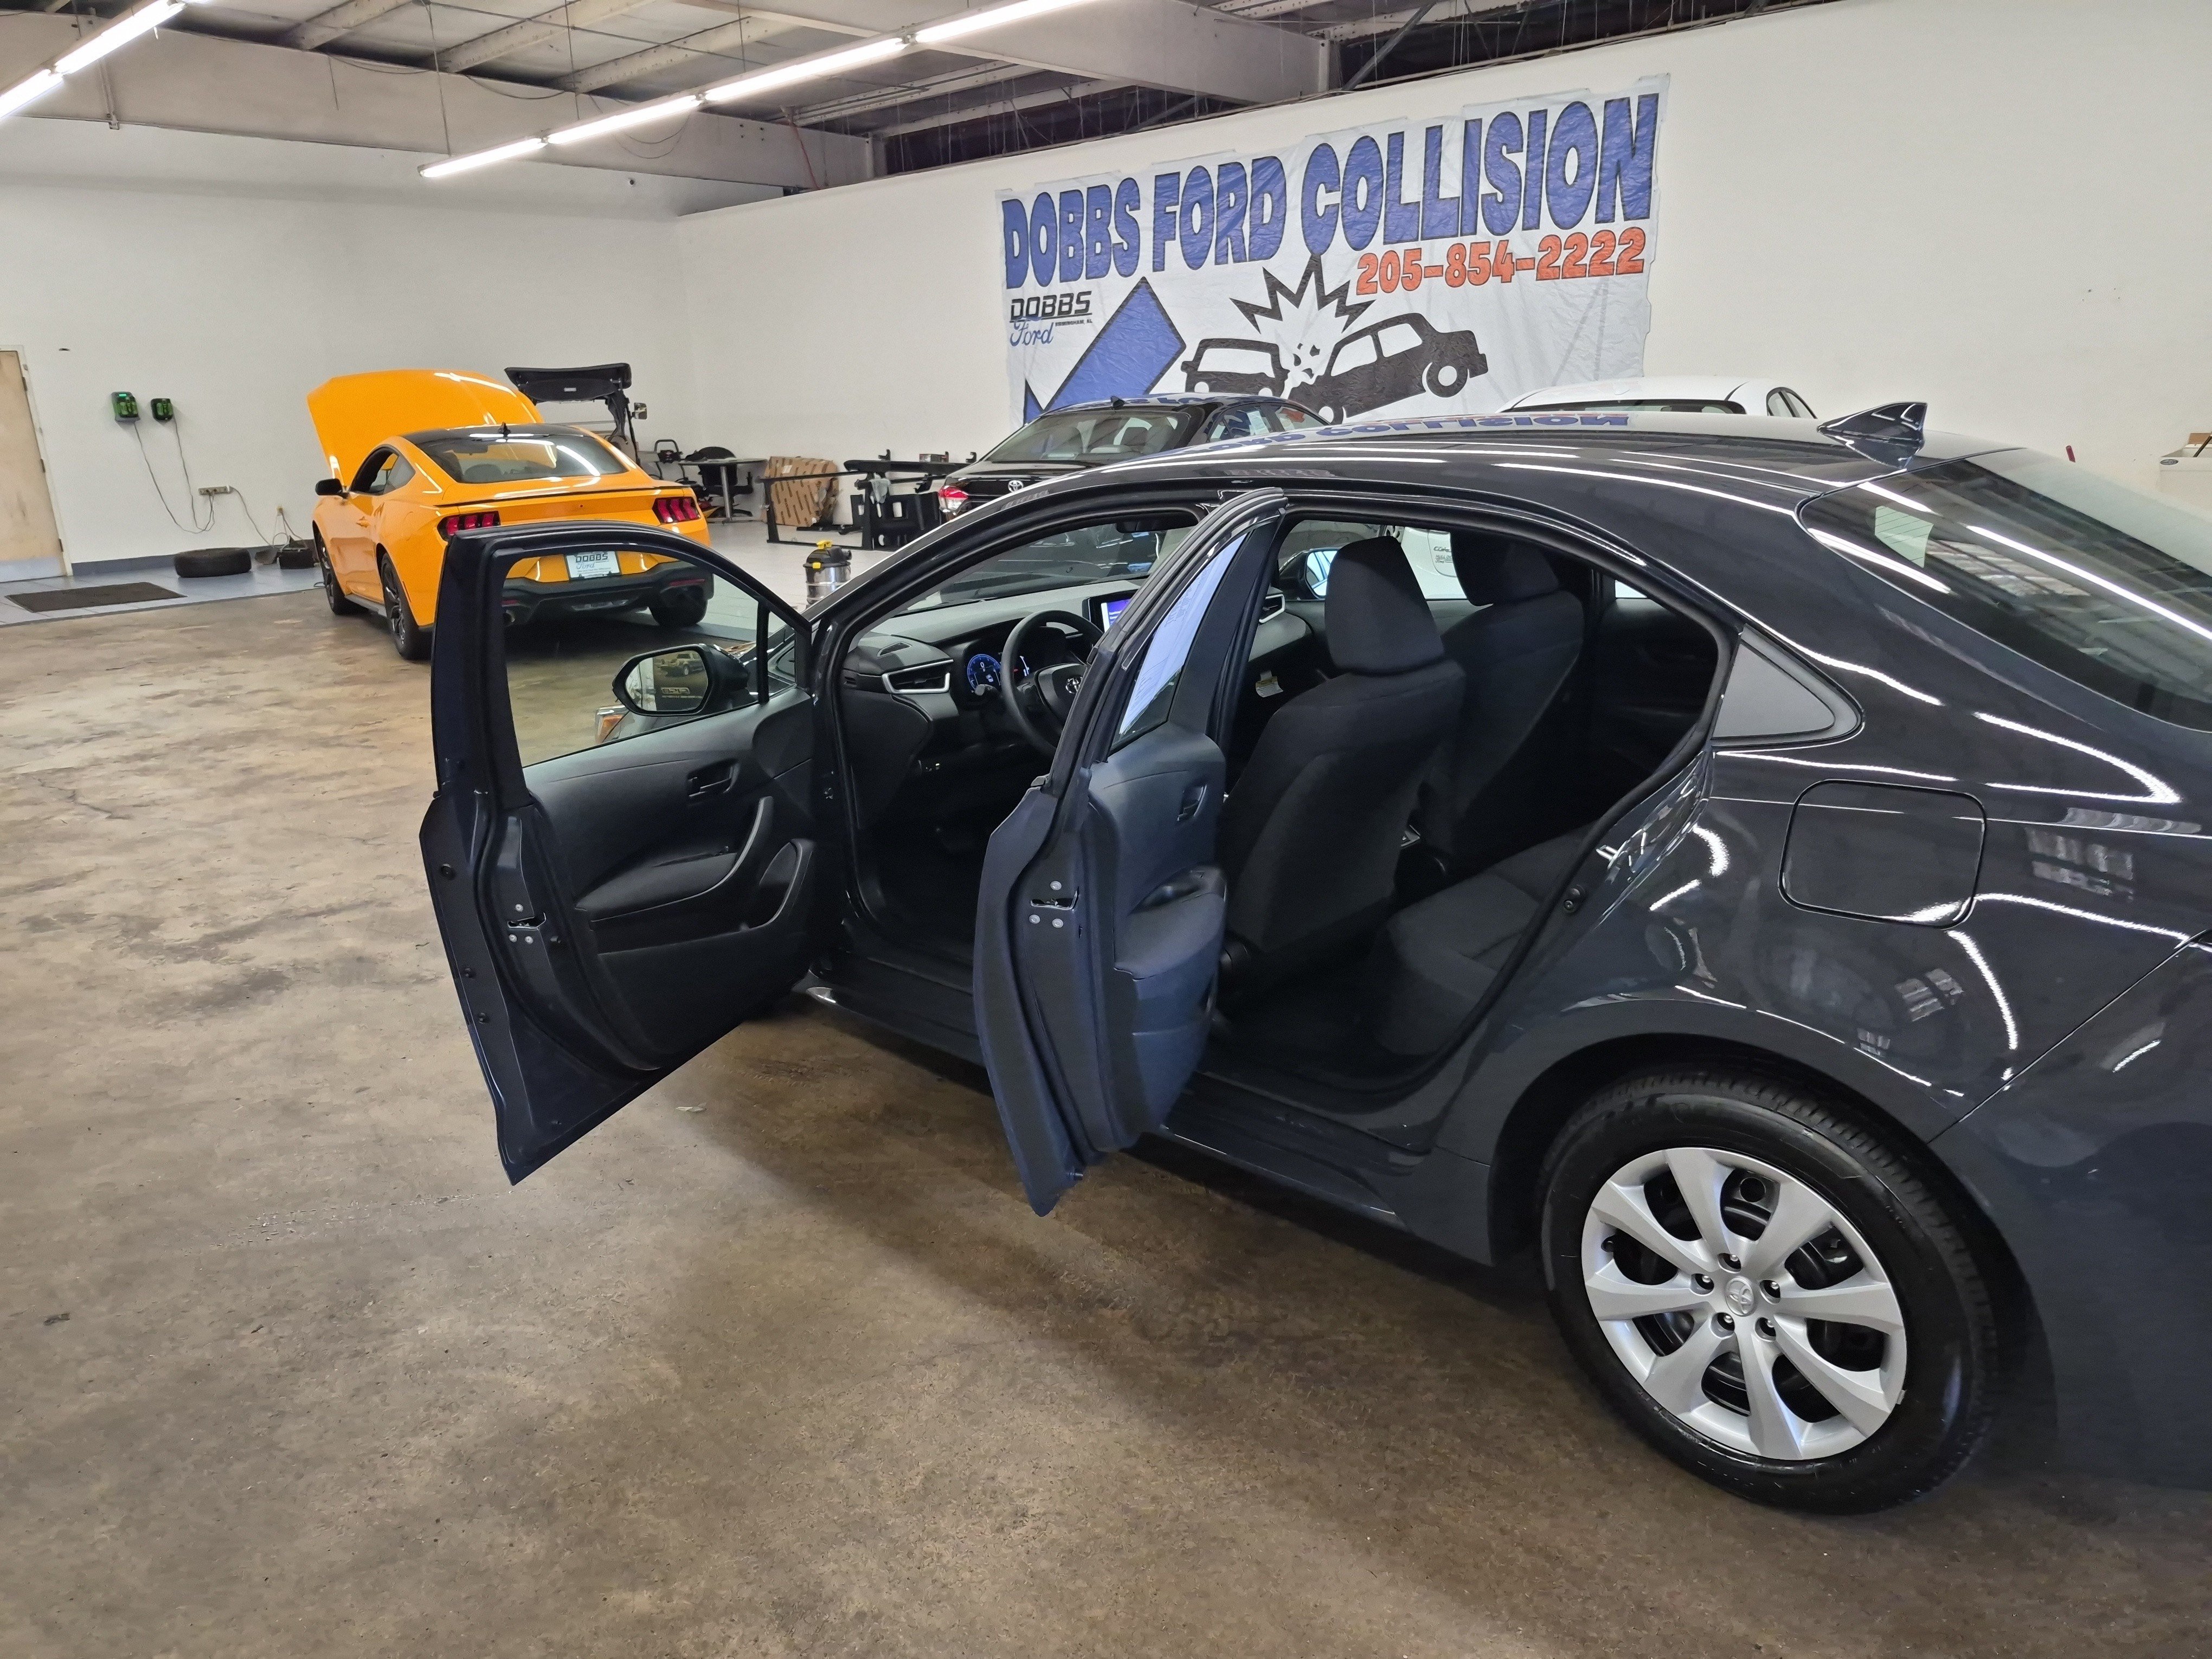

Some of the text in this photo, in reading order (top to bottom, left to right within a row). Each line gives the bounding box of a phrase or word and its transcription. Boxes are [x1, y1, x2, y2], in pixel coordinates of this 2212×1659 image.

[1002, 93, 1660, 290] DOBBS FORD COLLISION
[1356, 226, 1646, 295] 205-854-2222
[1010, 291, 1092, 320] DOBBS
[1010, 316, 1054, 347] Ford
[576, 553, 608, 563] DOBBS
[576, 561, 595, 569] Ford
